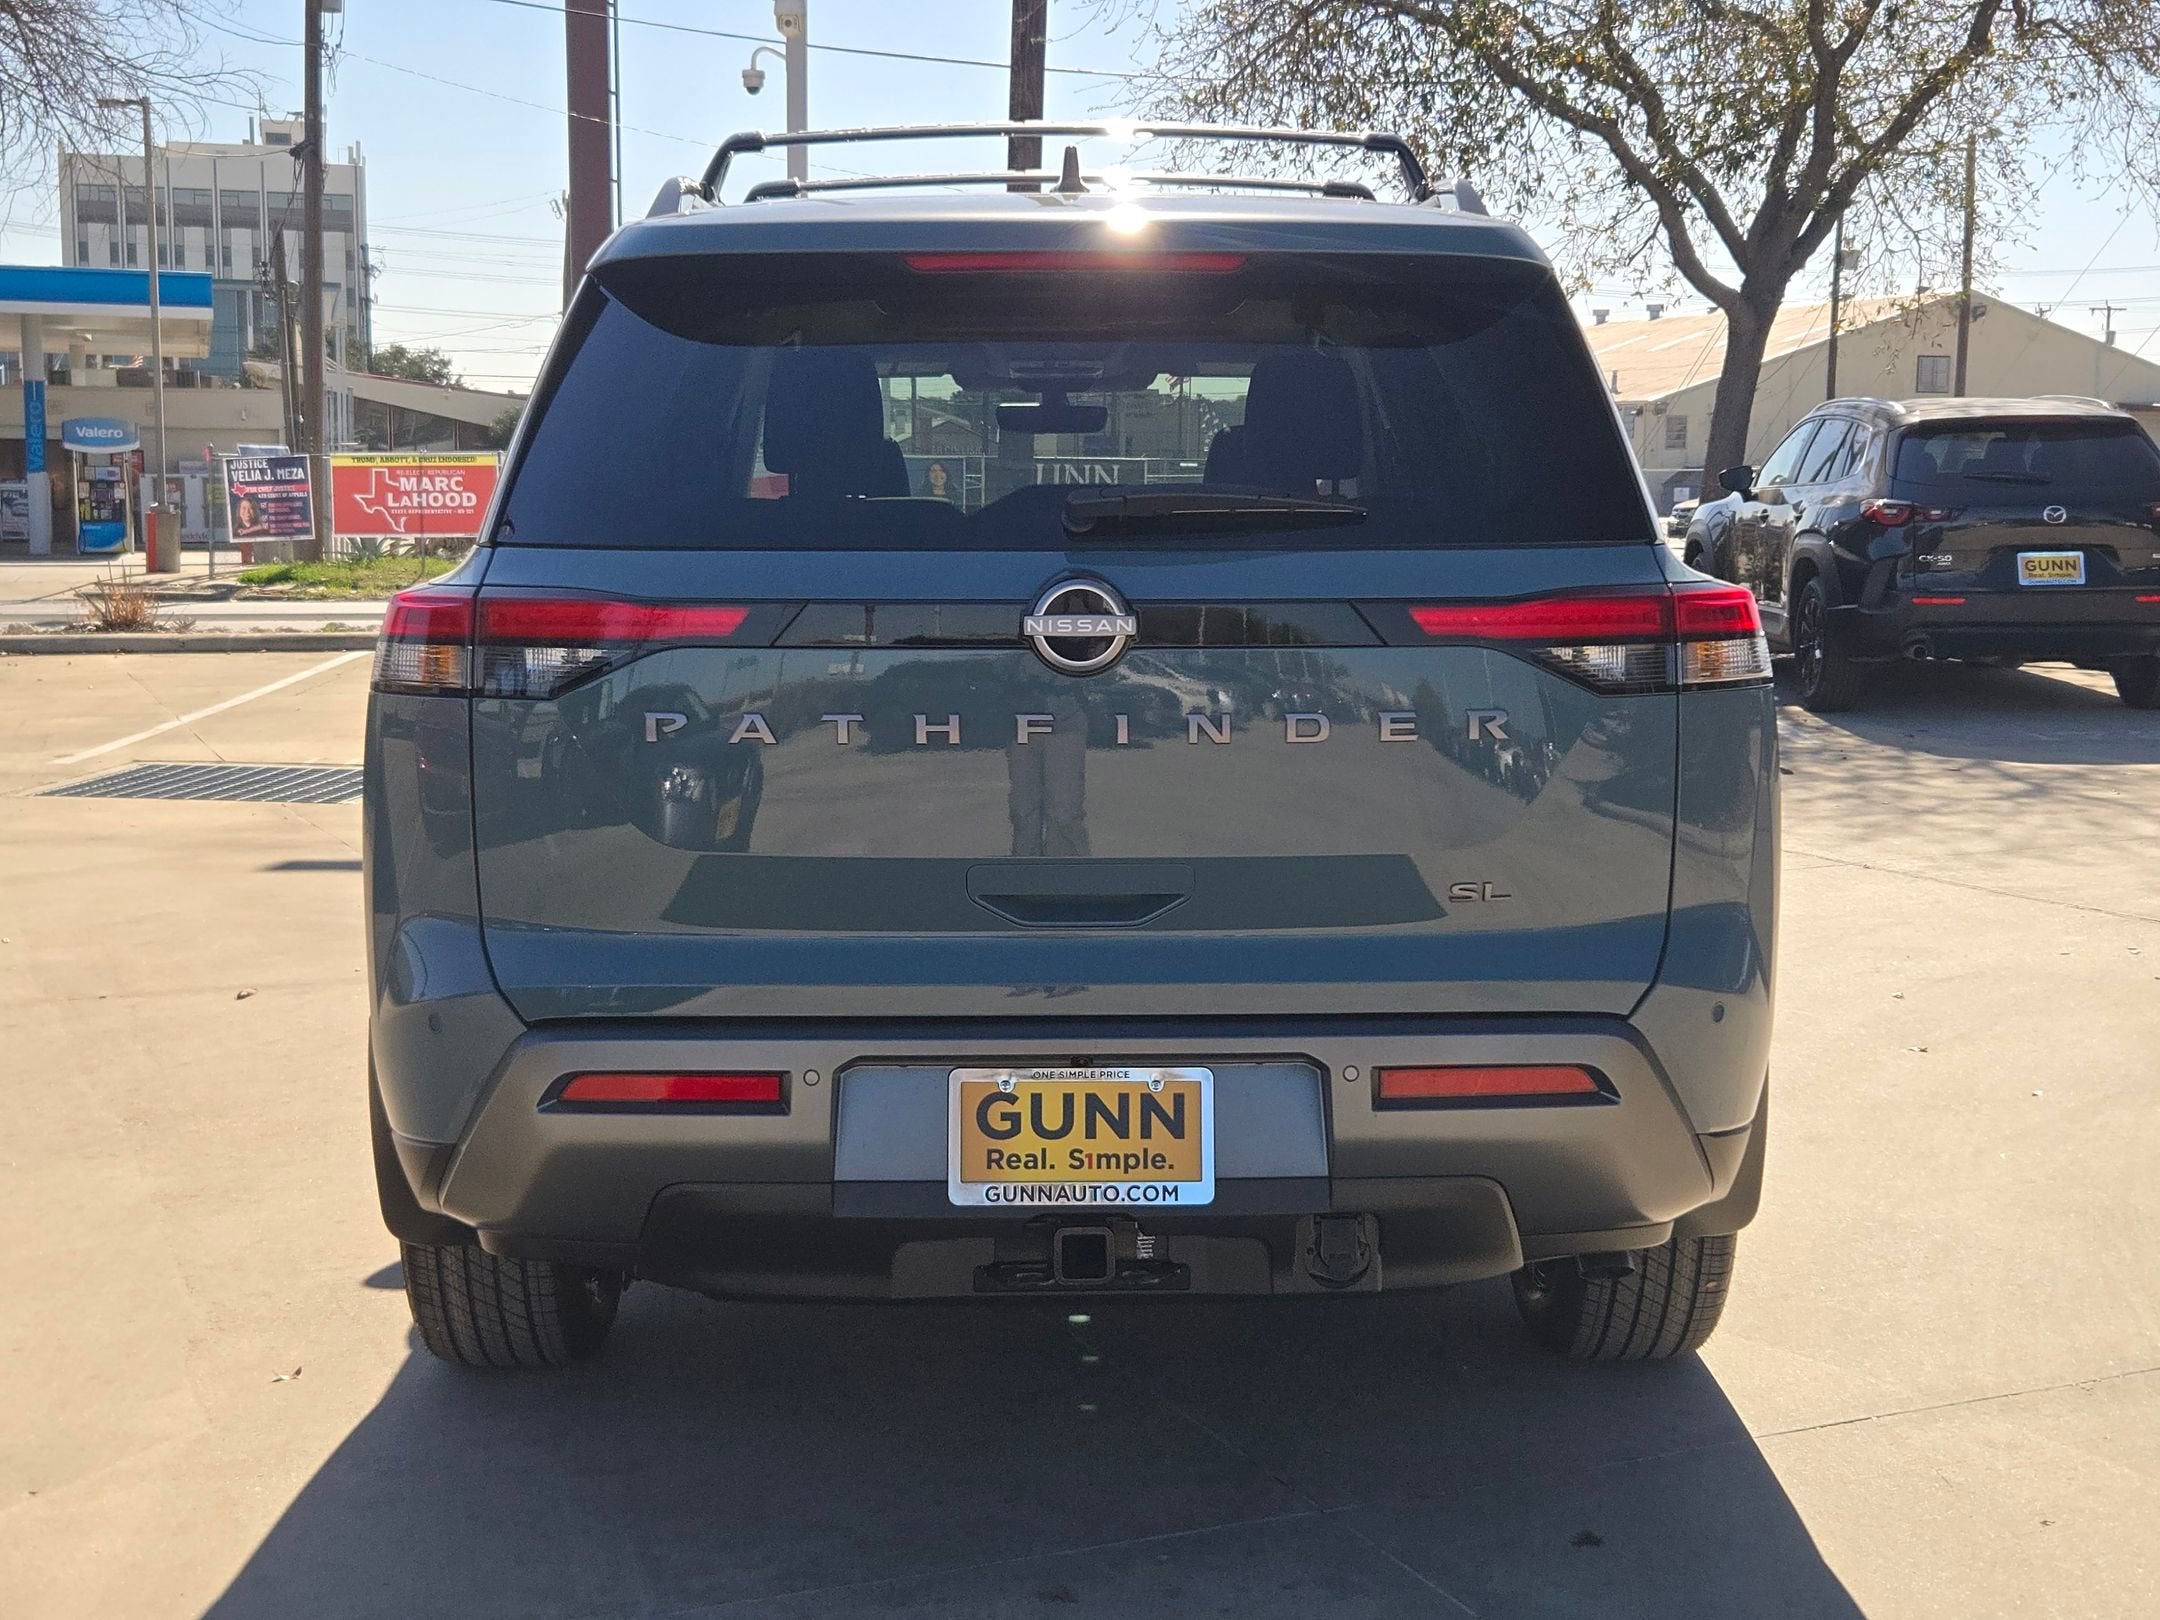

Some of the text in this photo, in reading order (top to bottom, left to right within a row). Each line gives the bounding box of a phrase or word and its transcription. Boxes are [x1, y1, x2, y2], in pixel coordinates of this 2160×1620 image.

[75, 426, 124, 439] Valero
[230, 458, 269, 470] JUSTICE
[231, 467, 306, 482] VELIA J. MEZA
[399, 476, 464, 492] MARC
[2024, 559, 2077, 572] GUNN
[1026, 619, 1133, 633] NISSAN
[642, 708, 1511, 746] PATHFINDER
[1447, 880, 1512, 903] SL
[1032, 1070, 1131, 1079] ONE SIMPLE PRICE
[975, 1091, 1186, 1141] GUNN
[986, 1147, 1056, 1171] Real.
[984, 1184, 1179, 1203] GUNNAUTO.COM
